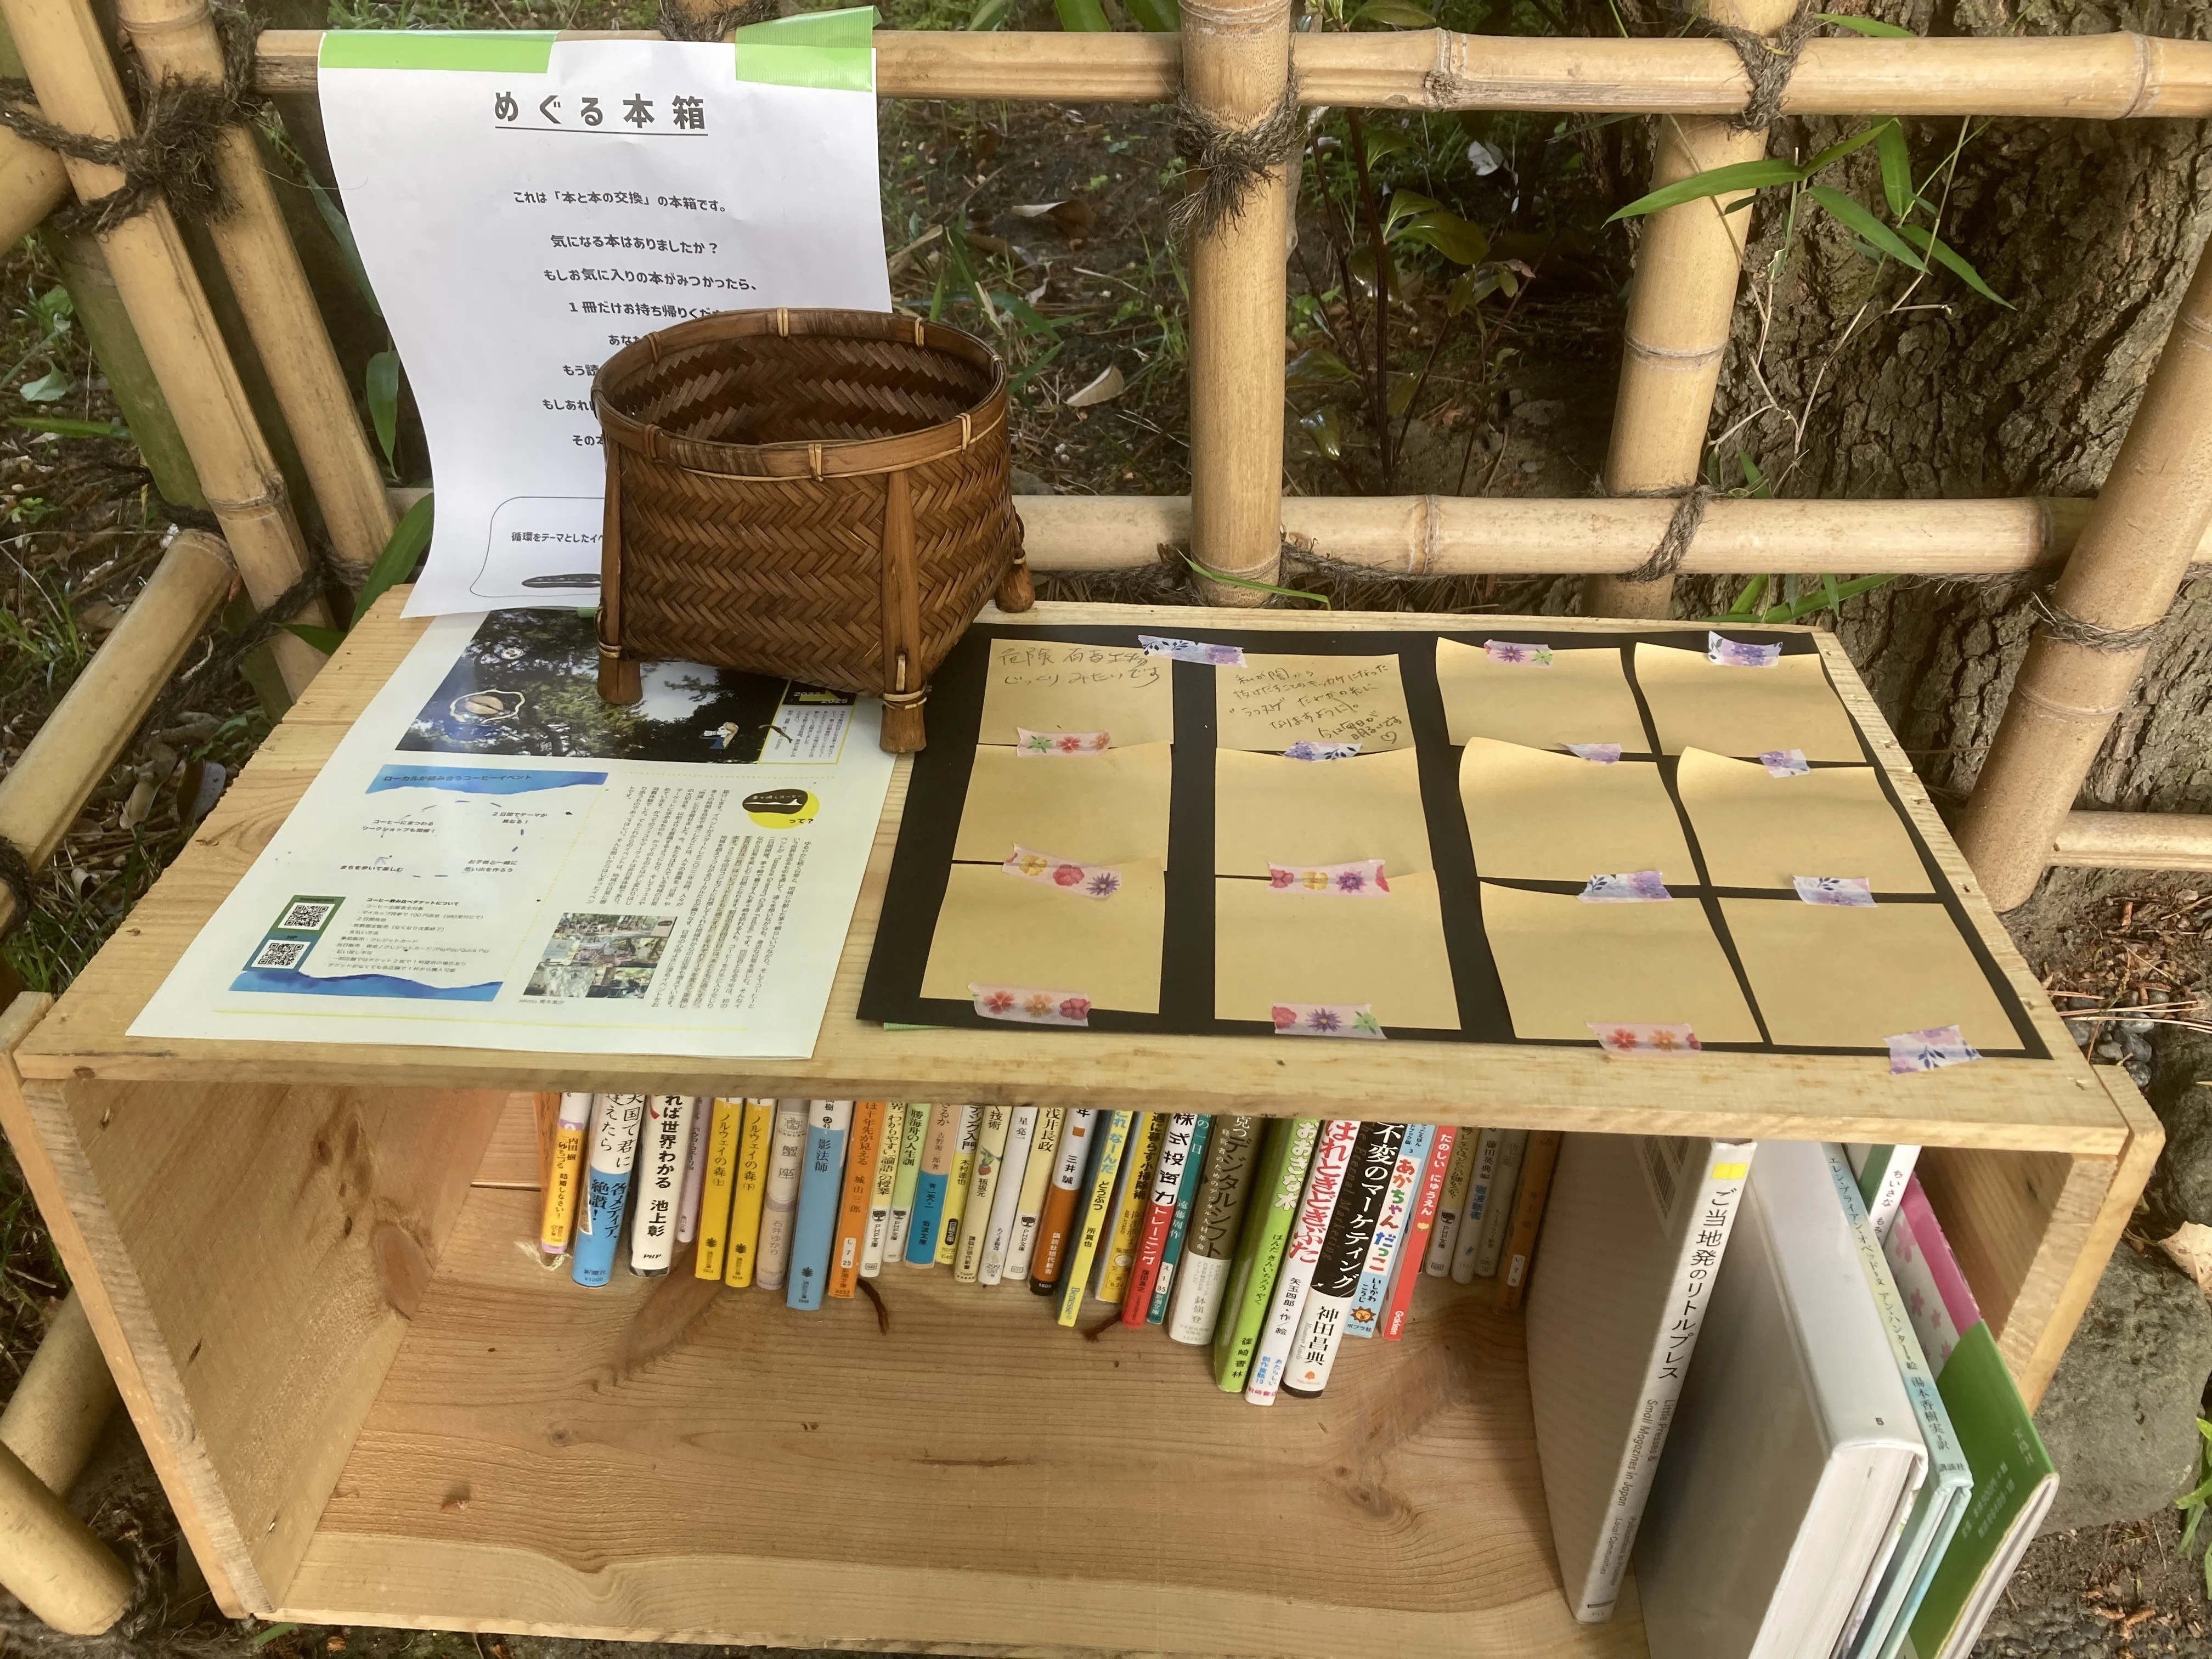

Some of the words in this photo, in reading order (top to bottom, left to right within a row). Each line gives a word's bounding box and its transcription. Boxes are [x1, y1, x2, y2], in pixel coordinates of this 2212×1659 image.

[495, 92, 707, 130] めぐる本箱
[513, 190, 726, 213] これは「本と本の交換」の本箱です。
[550, 234, 718, 256] 気になる本はありましたか？
[543, 267, 757, 292] もしお気に入りの本がみつかったら、
[902, 1109, 924, 1166] 勝海舟の人生訓
[1015, 1117, 1028, 1139] 星亮一
[1038, 1107, 1061, 1152] 浅井長政
[778, 1145, 798, 1179] 蟹座
[815, 1138, 831, 1172] 影法師
[1062, 1154, 1078, 1184] 三井誠
[1274, 1121, 1319, 1211] おおきな木
[1434, 1133, 1453, 1168] たのしい
[849, 1175, 865, 1213] 城山三郎
[1207, 1136, 1252, 1257] デジタルシフト
[1289, 1120, 1357, 1263] はれときどきぶた
[1332, 1122, 1404, 1289] 不変のマーケティング
[1380, 1159, 1415, 1228] あかちゃん
[1421, 1174, 1442, 1216] にゅうえん
[1882, 1170, 1903, 1207] ちいさな
[647, 1200, 669, 1237] 池上彰
[1142, 1207, 1167, 1265] トレーニング
[1170, 1200, 1188, 1239] 遠藤周作
[770, 1220, 783, 1256] 石井ゆかり
[1369, 1232, 1396, 1271] だっこ
[1367, 1278, 1381, 1302] いしかわ
[1658, 1188, 1737, 1379] ご当地発のリトルプレス
[1304, 1306, 1339, 1365] 神田昌典
[1347, 1323, 1372, 1332] ポプラ社
[1390, 1311, 1404, 1335] Gakken
[1232, 1338, 1253, 1378] 篠崎書林
[1642, 1399, 1658, 1424] Small
[1659, 1400, 1675, 1421] Little
[1875, 1417, 1884, 1425] 5
[1628, 1425, 1650, 1470] Magazines
[1618, 1482, 1634, 1506] Japan
